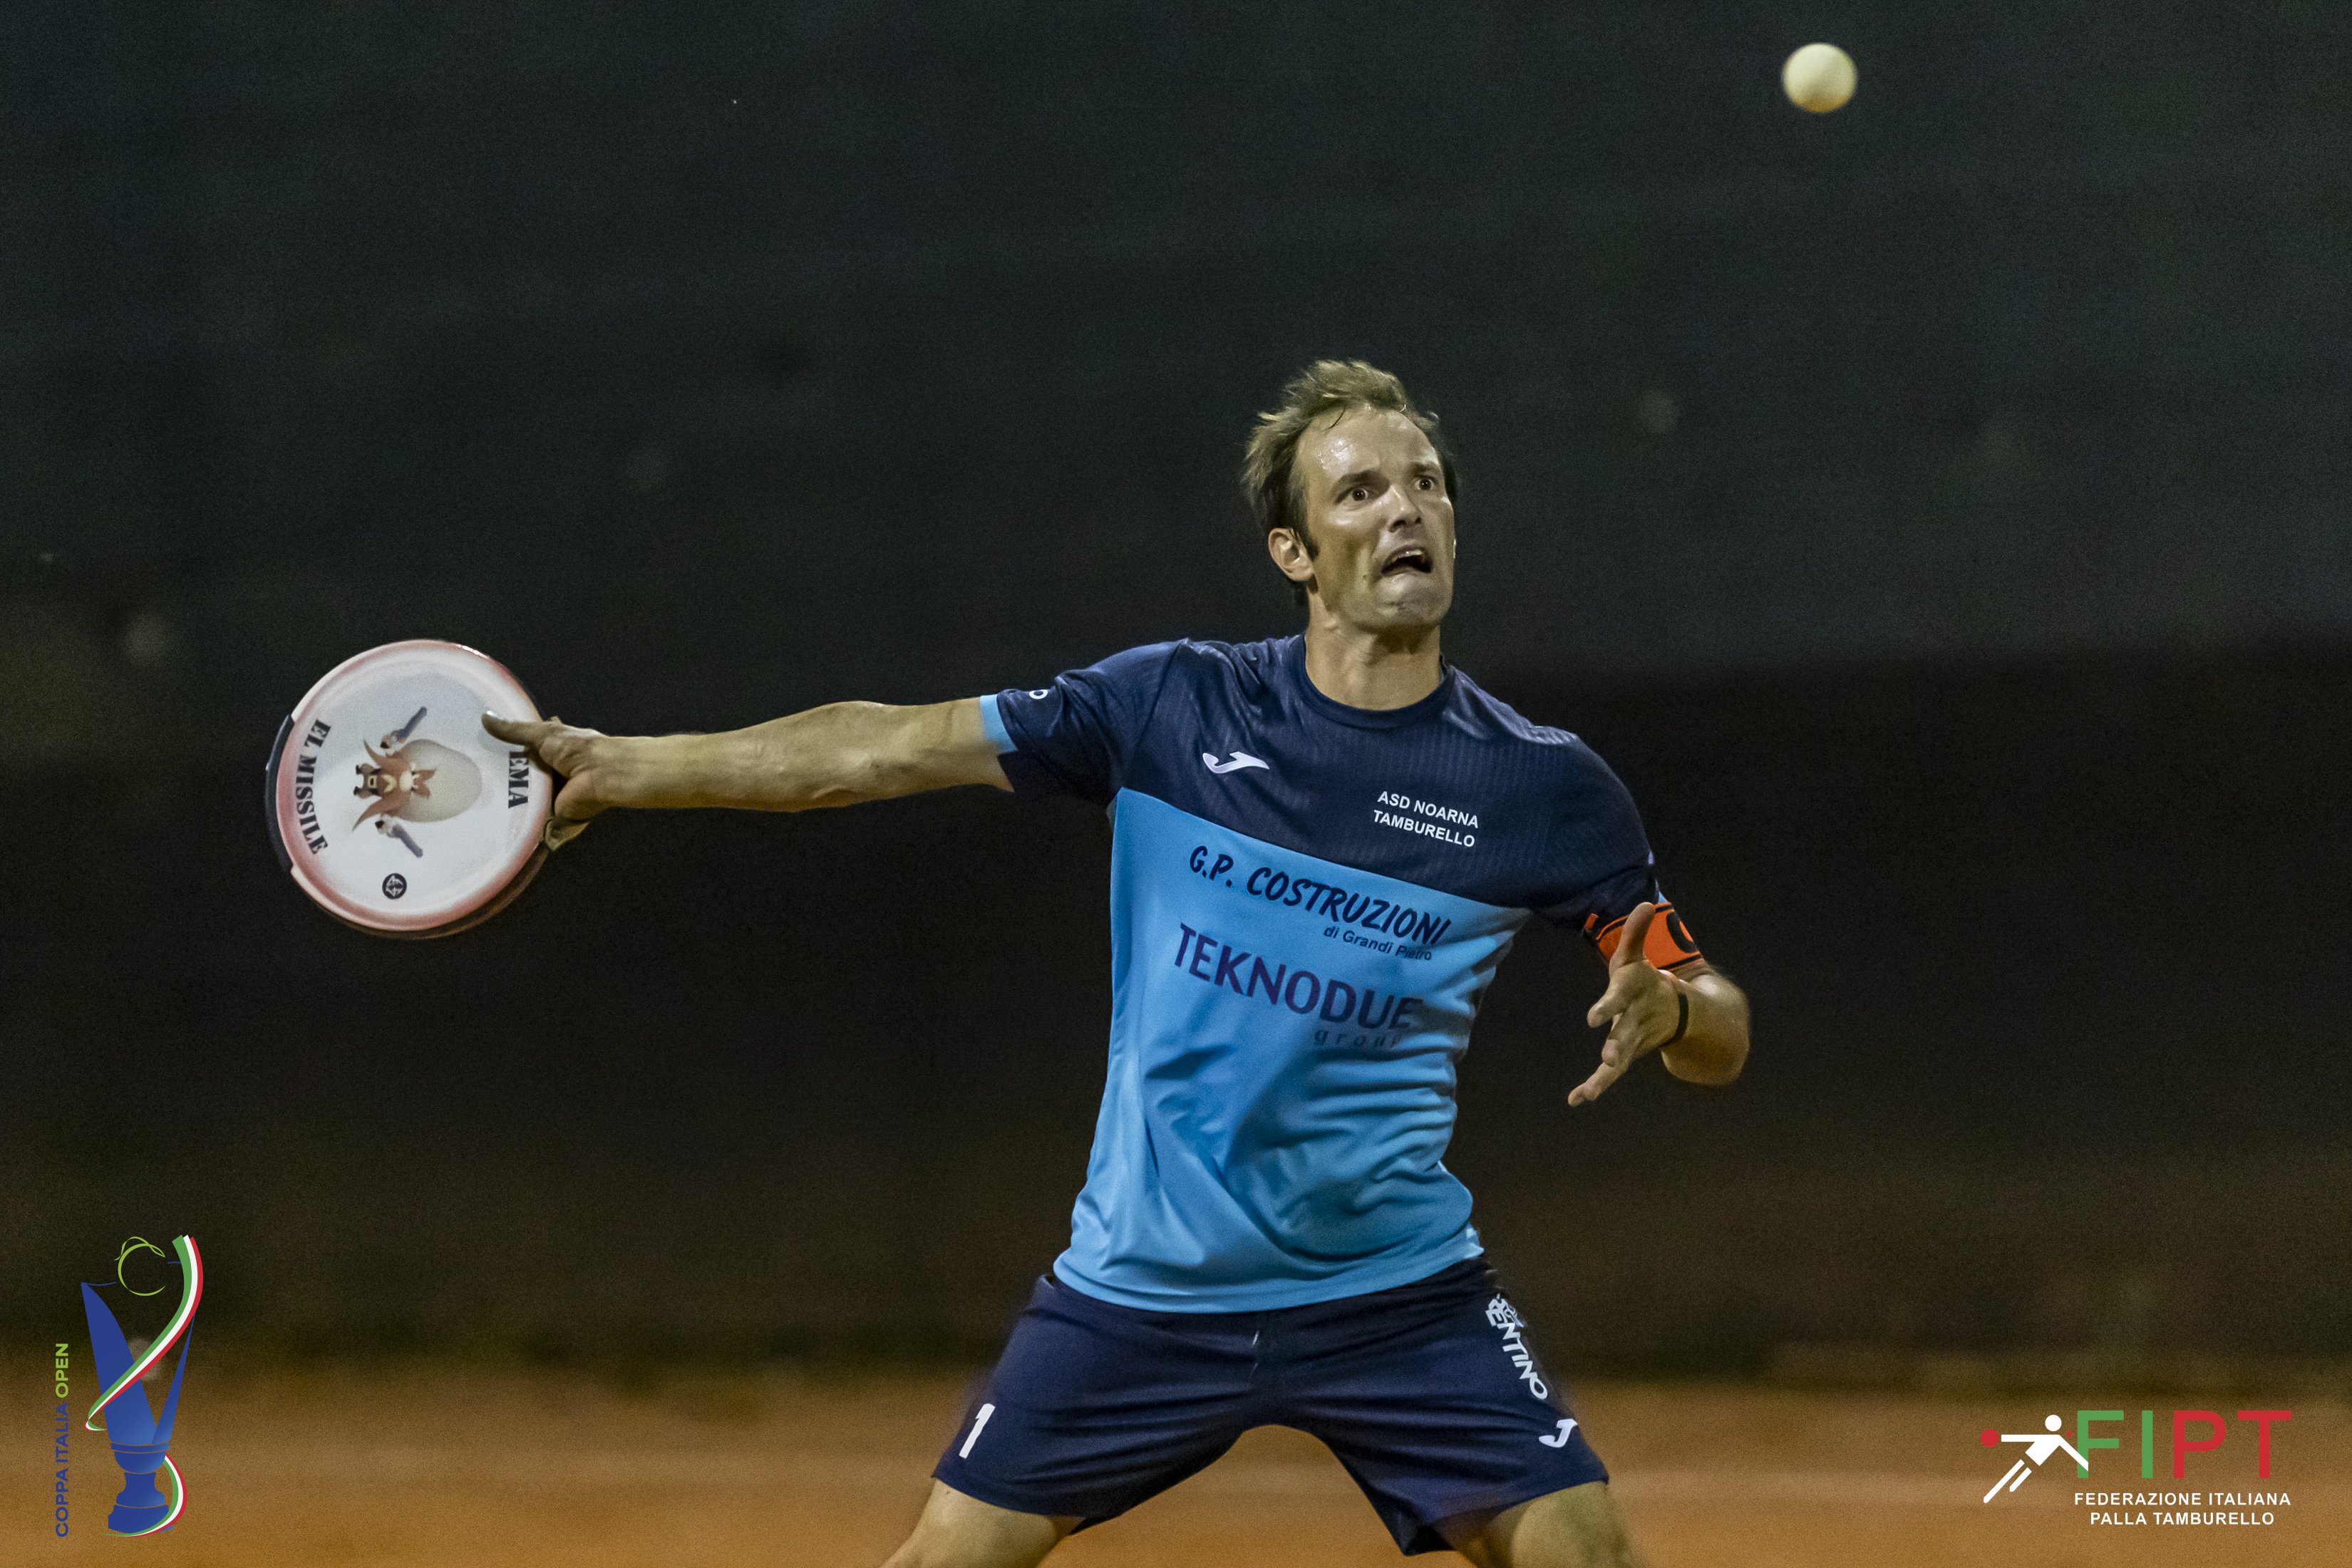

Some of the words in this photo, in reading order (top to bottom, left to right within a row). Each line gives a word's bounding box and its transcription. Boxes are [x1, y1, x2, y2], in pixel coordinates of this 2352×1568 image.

[304, 718, 331, 748] EL
[295, 754, 329, 855] MISSILE
[1373, 809, 1475, 847] TAMBURELLO
[1377, 790, 1410, 809] ASD
[1413, 800, 1478, 829] NOARNA
[1190, 845, 1234, 888] G.P.
[1247, 867, 1452, 946] COSTRUZIONI
[1323, 926, 1339, 939] di
[1342, 929, 1394, 954] Grandi
[1395, 944, 1433, 961] Pietro
[1174, 922, 1424, 1030] TEKNODUE
[959, 1403, 996, 1459] 1
